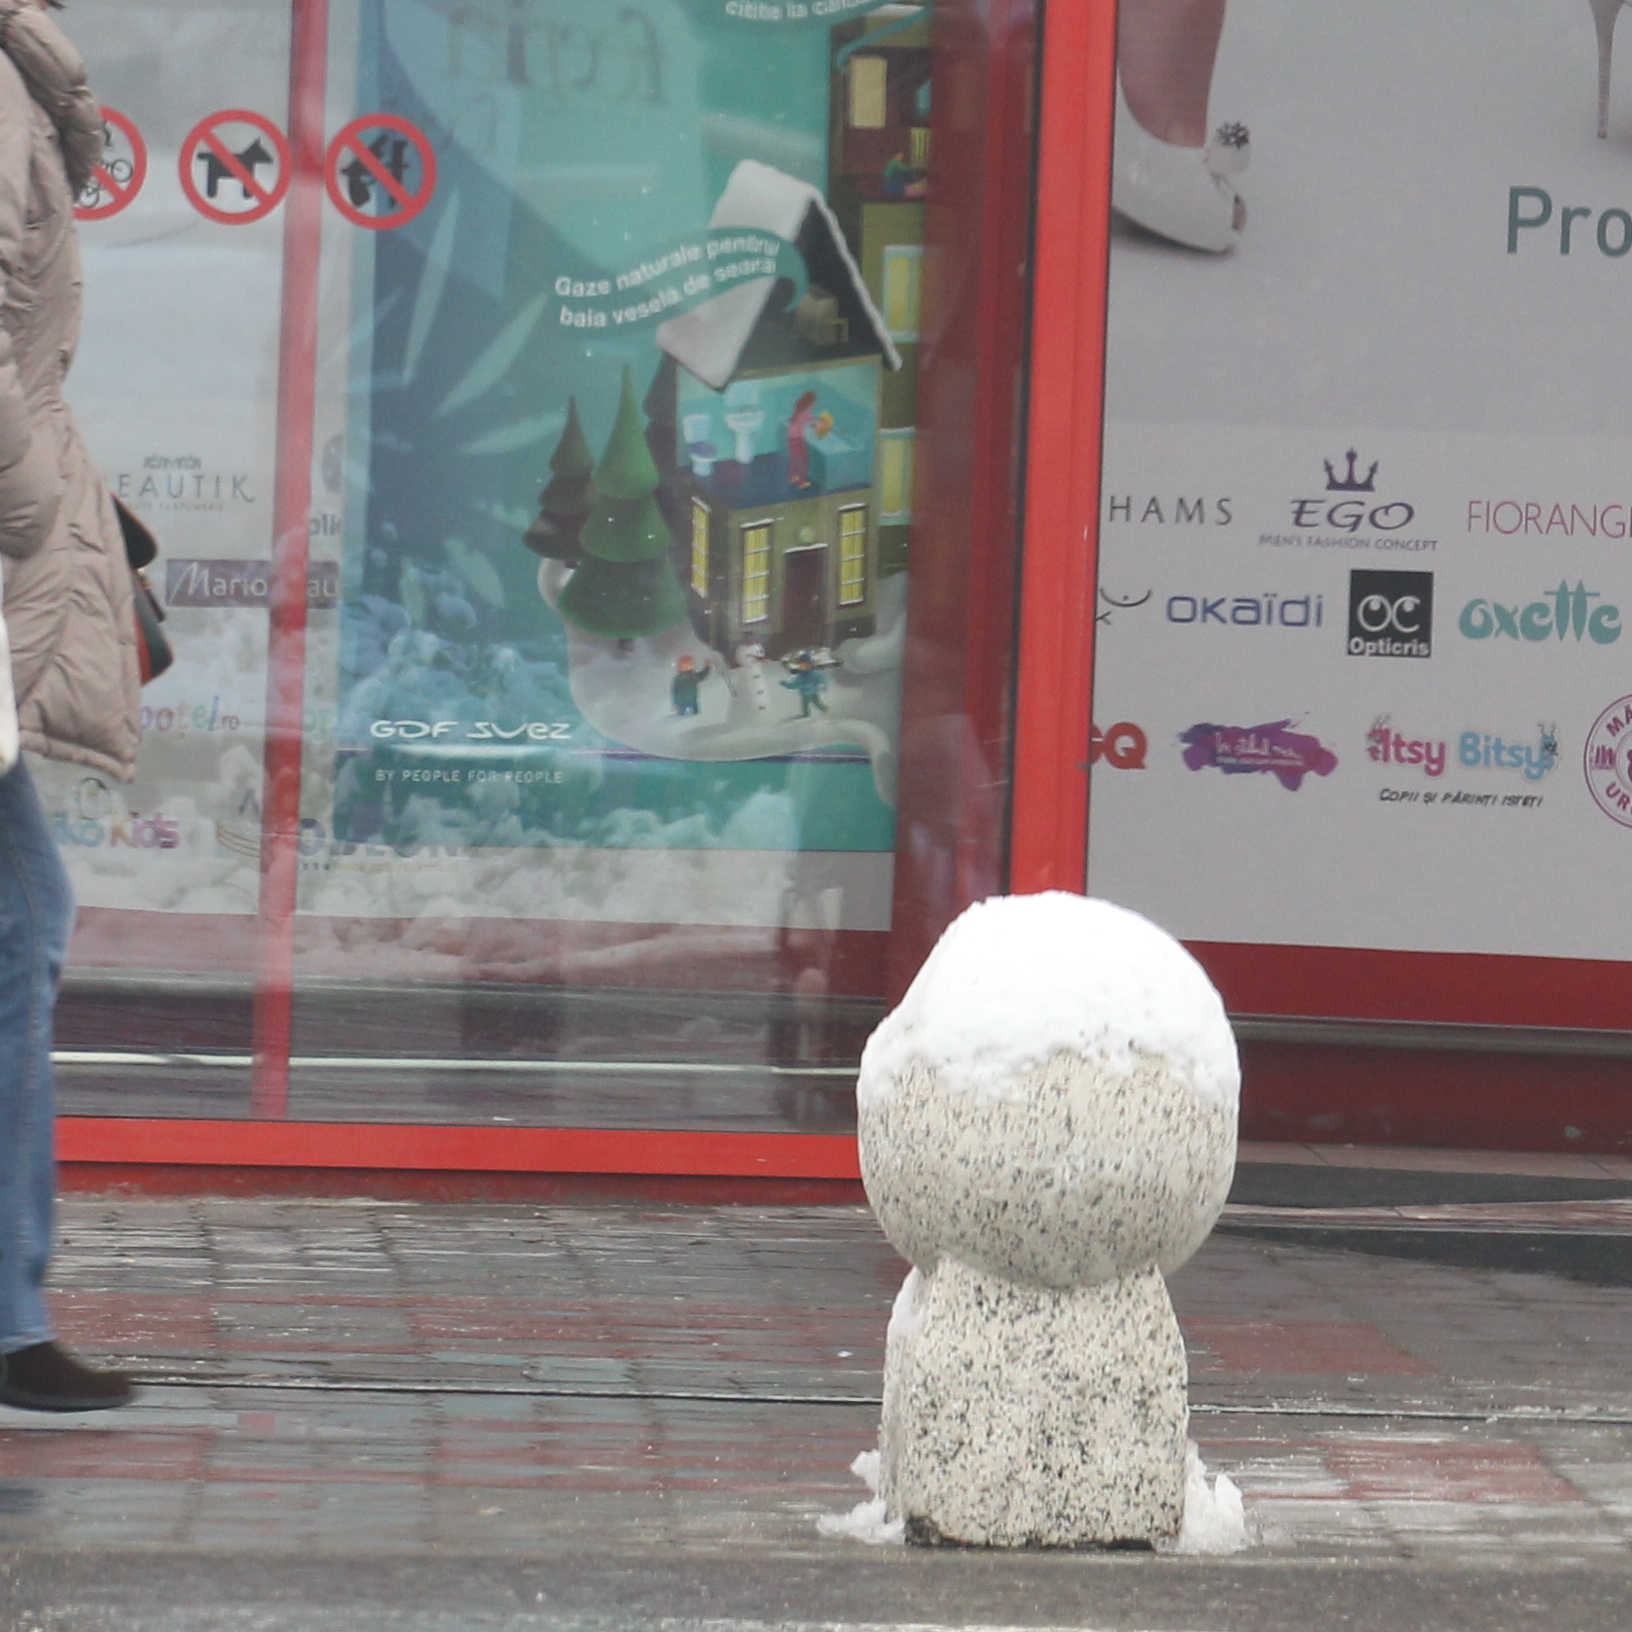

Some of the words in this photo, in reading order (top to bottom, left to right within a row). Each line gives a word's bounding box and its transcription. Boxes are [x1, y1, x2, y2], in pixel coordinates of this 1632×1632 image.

[554, 275, 612, 298] Gaze
[615, 244, 701, 291] naturale
[706, 234, 780, 260] pentru
[686, 273, 711, 296] de
[117, 473, 256, 503] EAUTIK
[1108, 495, 1233, 526] HAMS
[1290, 498, 1415, 533] EGO
[1307, 536, 1370, 550] FASHION
[1374, 537, 1438, 552] CONCEPT
[1458, 578, 1622, 645] oxette
[1349, 637, 1429, 656] Opticris
[370, 720, 457, 739] GDF
[1458, 731, 1558, 781] Bitsy
[401, 770, 460, 782] PEOPLE
[468, 771, 499, 782] FOR
[504, 772, 563, 783] PEOPLE
